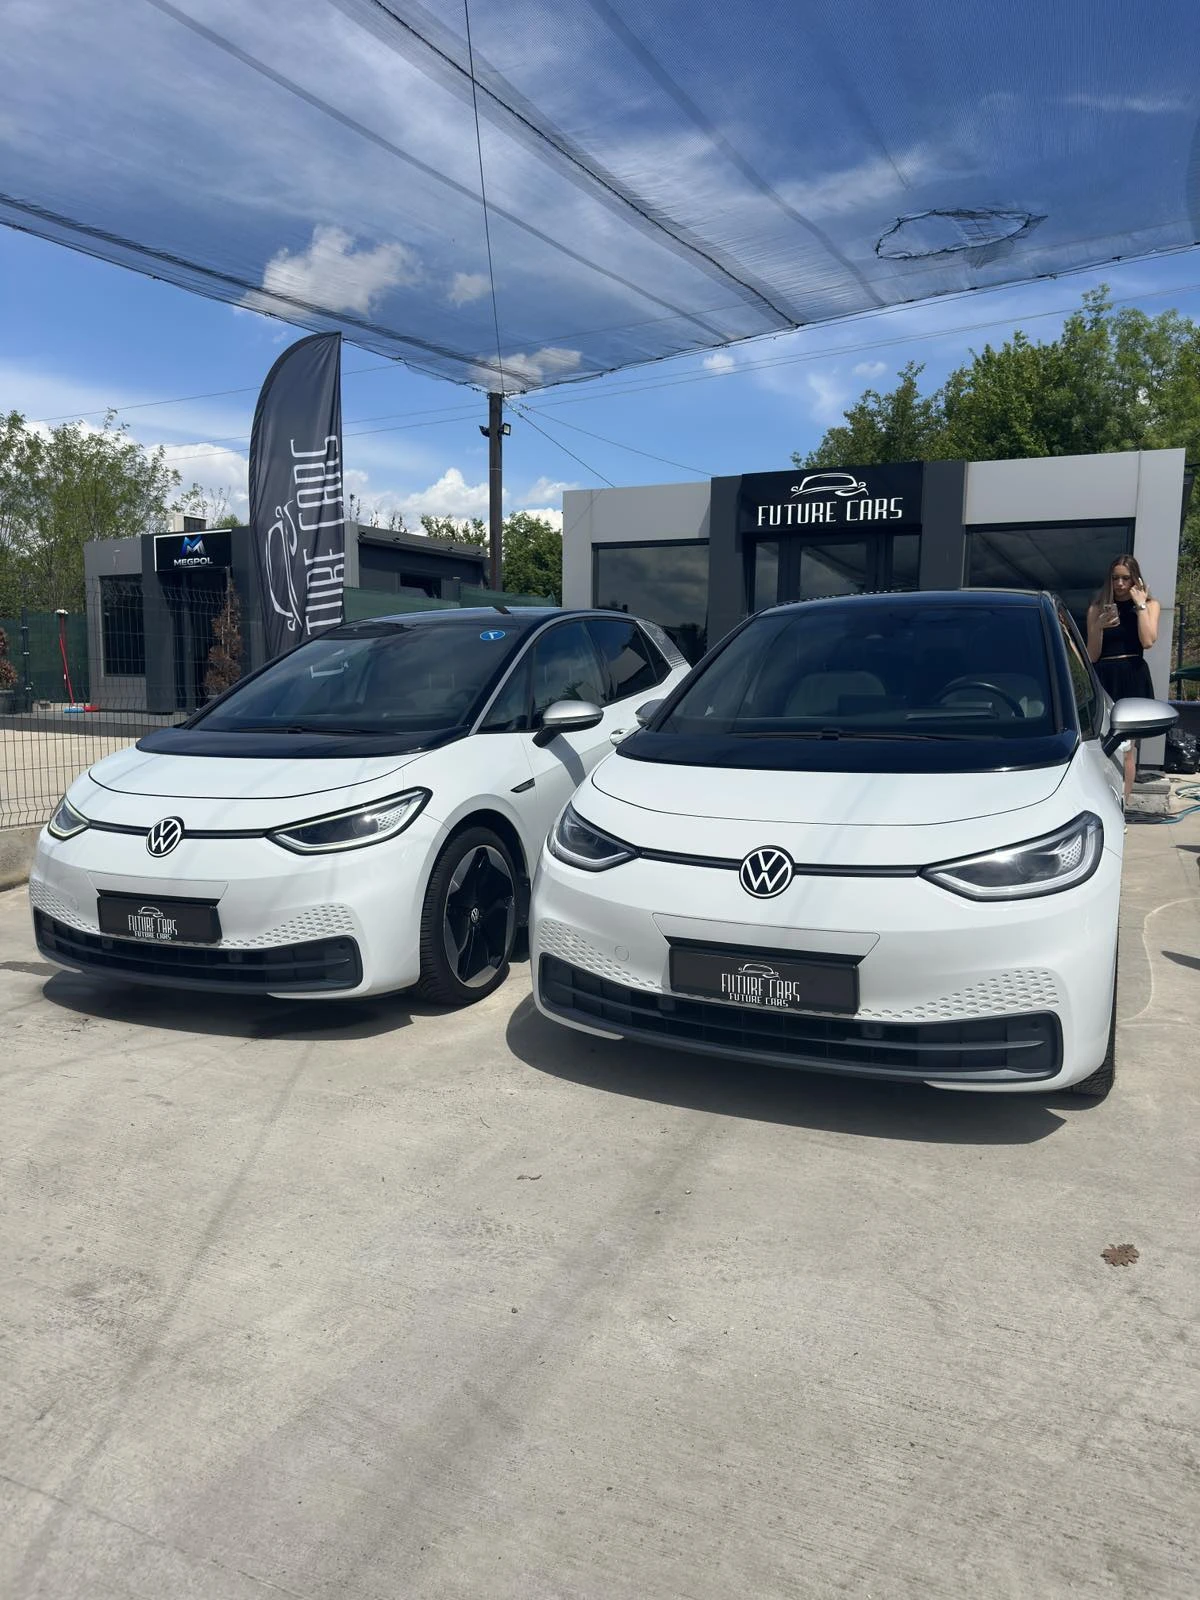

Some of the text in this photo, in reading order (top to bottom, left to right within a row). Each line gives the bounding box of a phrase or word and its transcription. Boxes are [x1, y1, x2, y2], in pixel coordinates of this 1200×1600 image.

[757, 497, 904, 526] FUTURE CARS
[173, 557, 213, 567] MEGPOL
[303, 549, 345, 635] TURE
[721, 973, 800, 1002] FUTURE CARS
[729, 993, 789, 1007] FUTURE CARS
